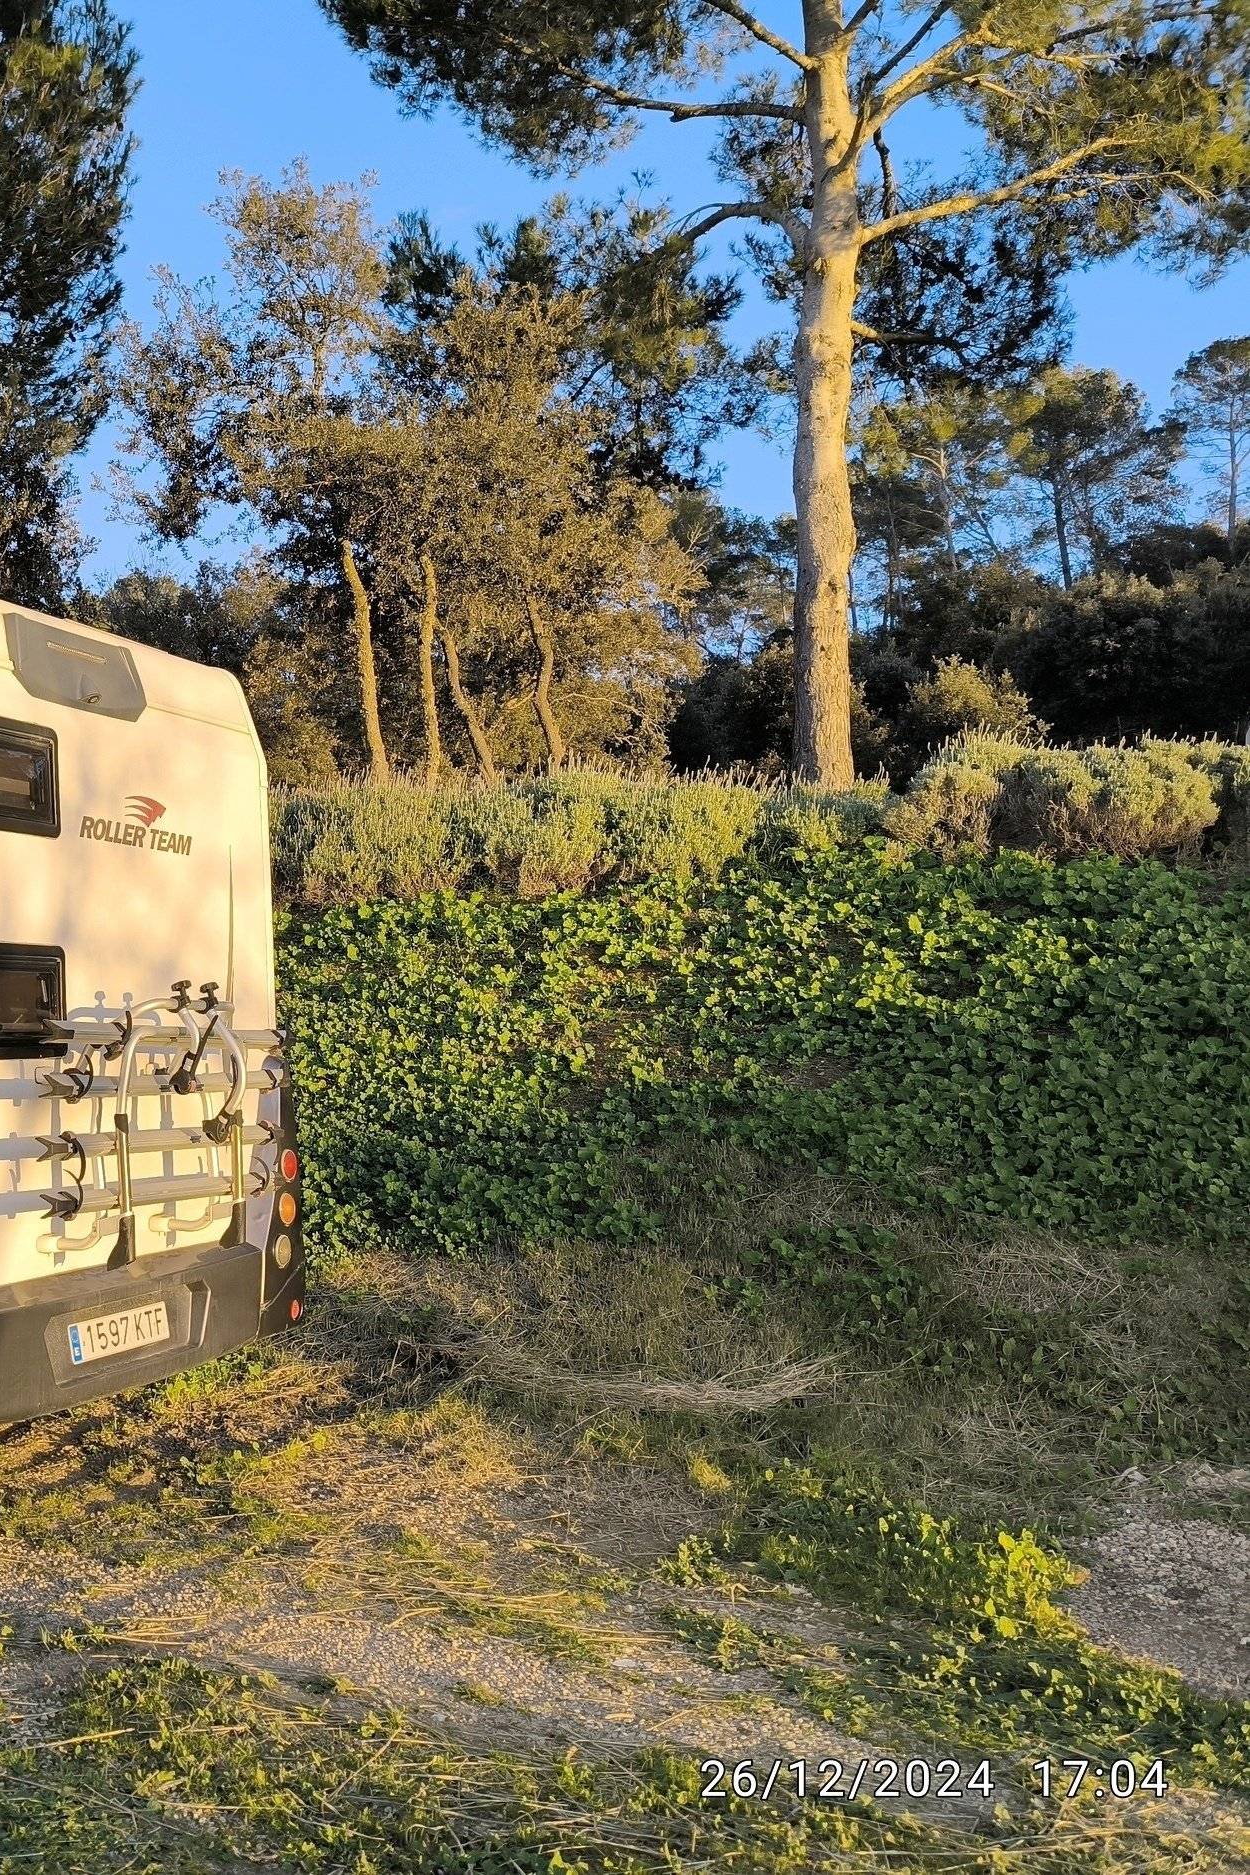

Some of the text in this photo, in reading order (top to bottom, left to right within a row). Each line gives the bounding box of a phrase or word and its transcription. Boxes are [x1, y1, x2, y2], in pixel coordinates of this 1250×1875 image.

[79, 815, 193, 856] ROLLER TEAM
[86, 1307, 163, 1353] 1597 KTF
